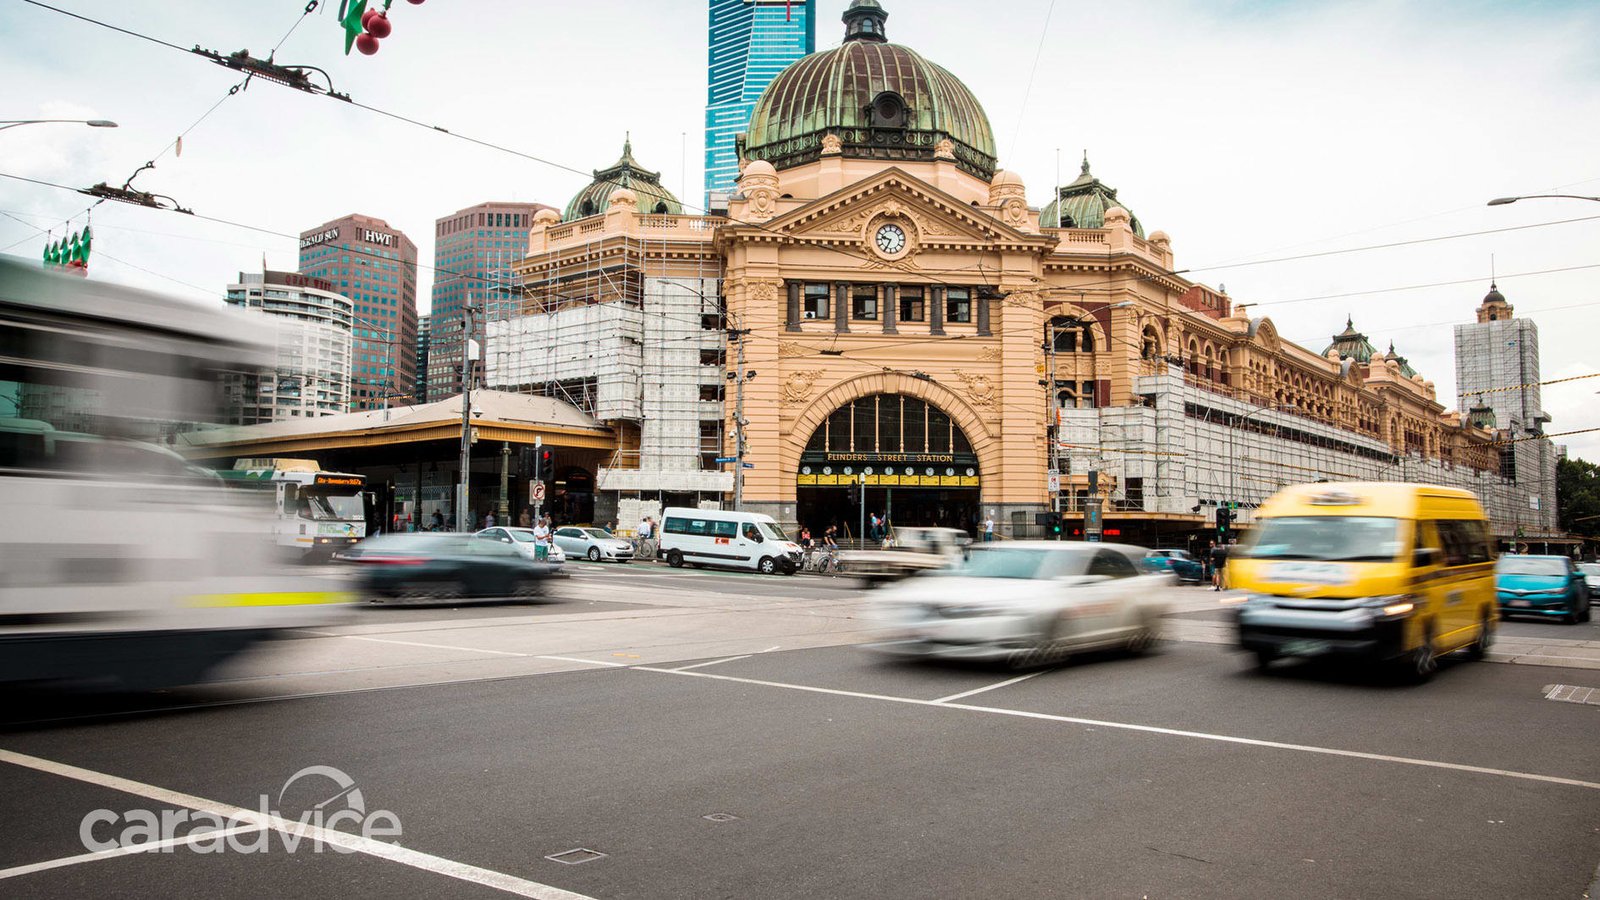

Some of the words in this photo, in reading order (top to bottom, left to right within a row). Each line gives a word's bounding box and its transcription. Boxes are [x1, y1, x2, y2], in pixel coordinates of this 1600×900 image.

[299, 233, 324, 249] HERALD
[324, 228, 339, 241] SUN
[365, 230, 392, 245] HWT
[827, 453, 868, 461] FLINDERS
[877, 454, 908, 462] STREET
[916, 454, 953, 462] STATION
